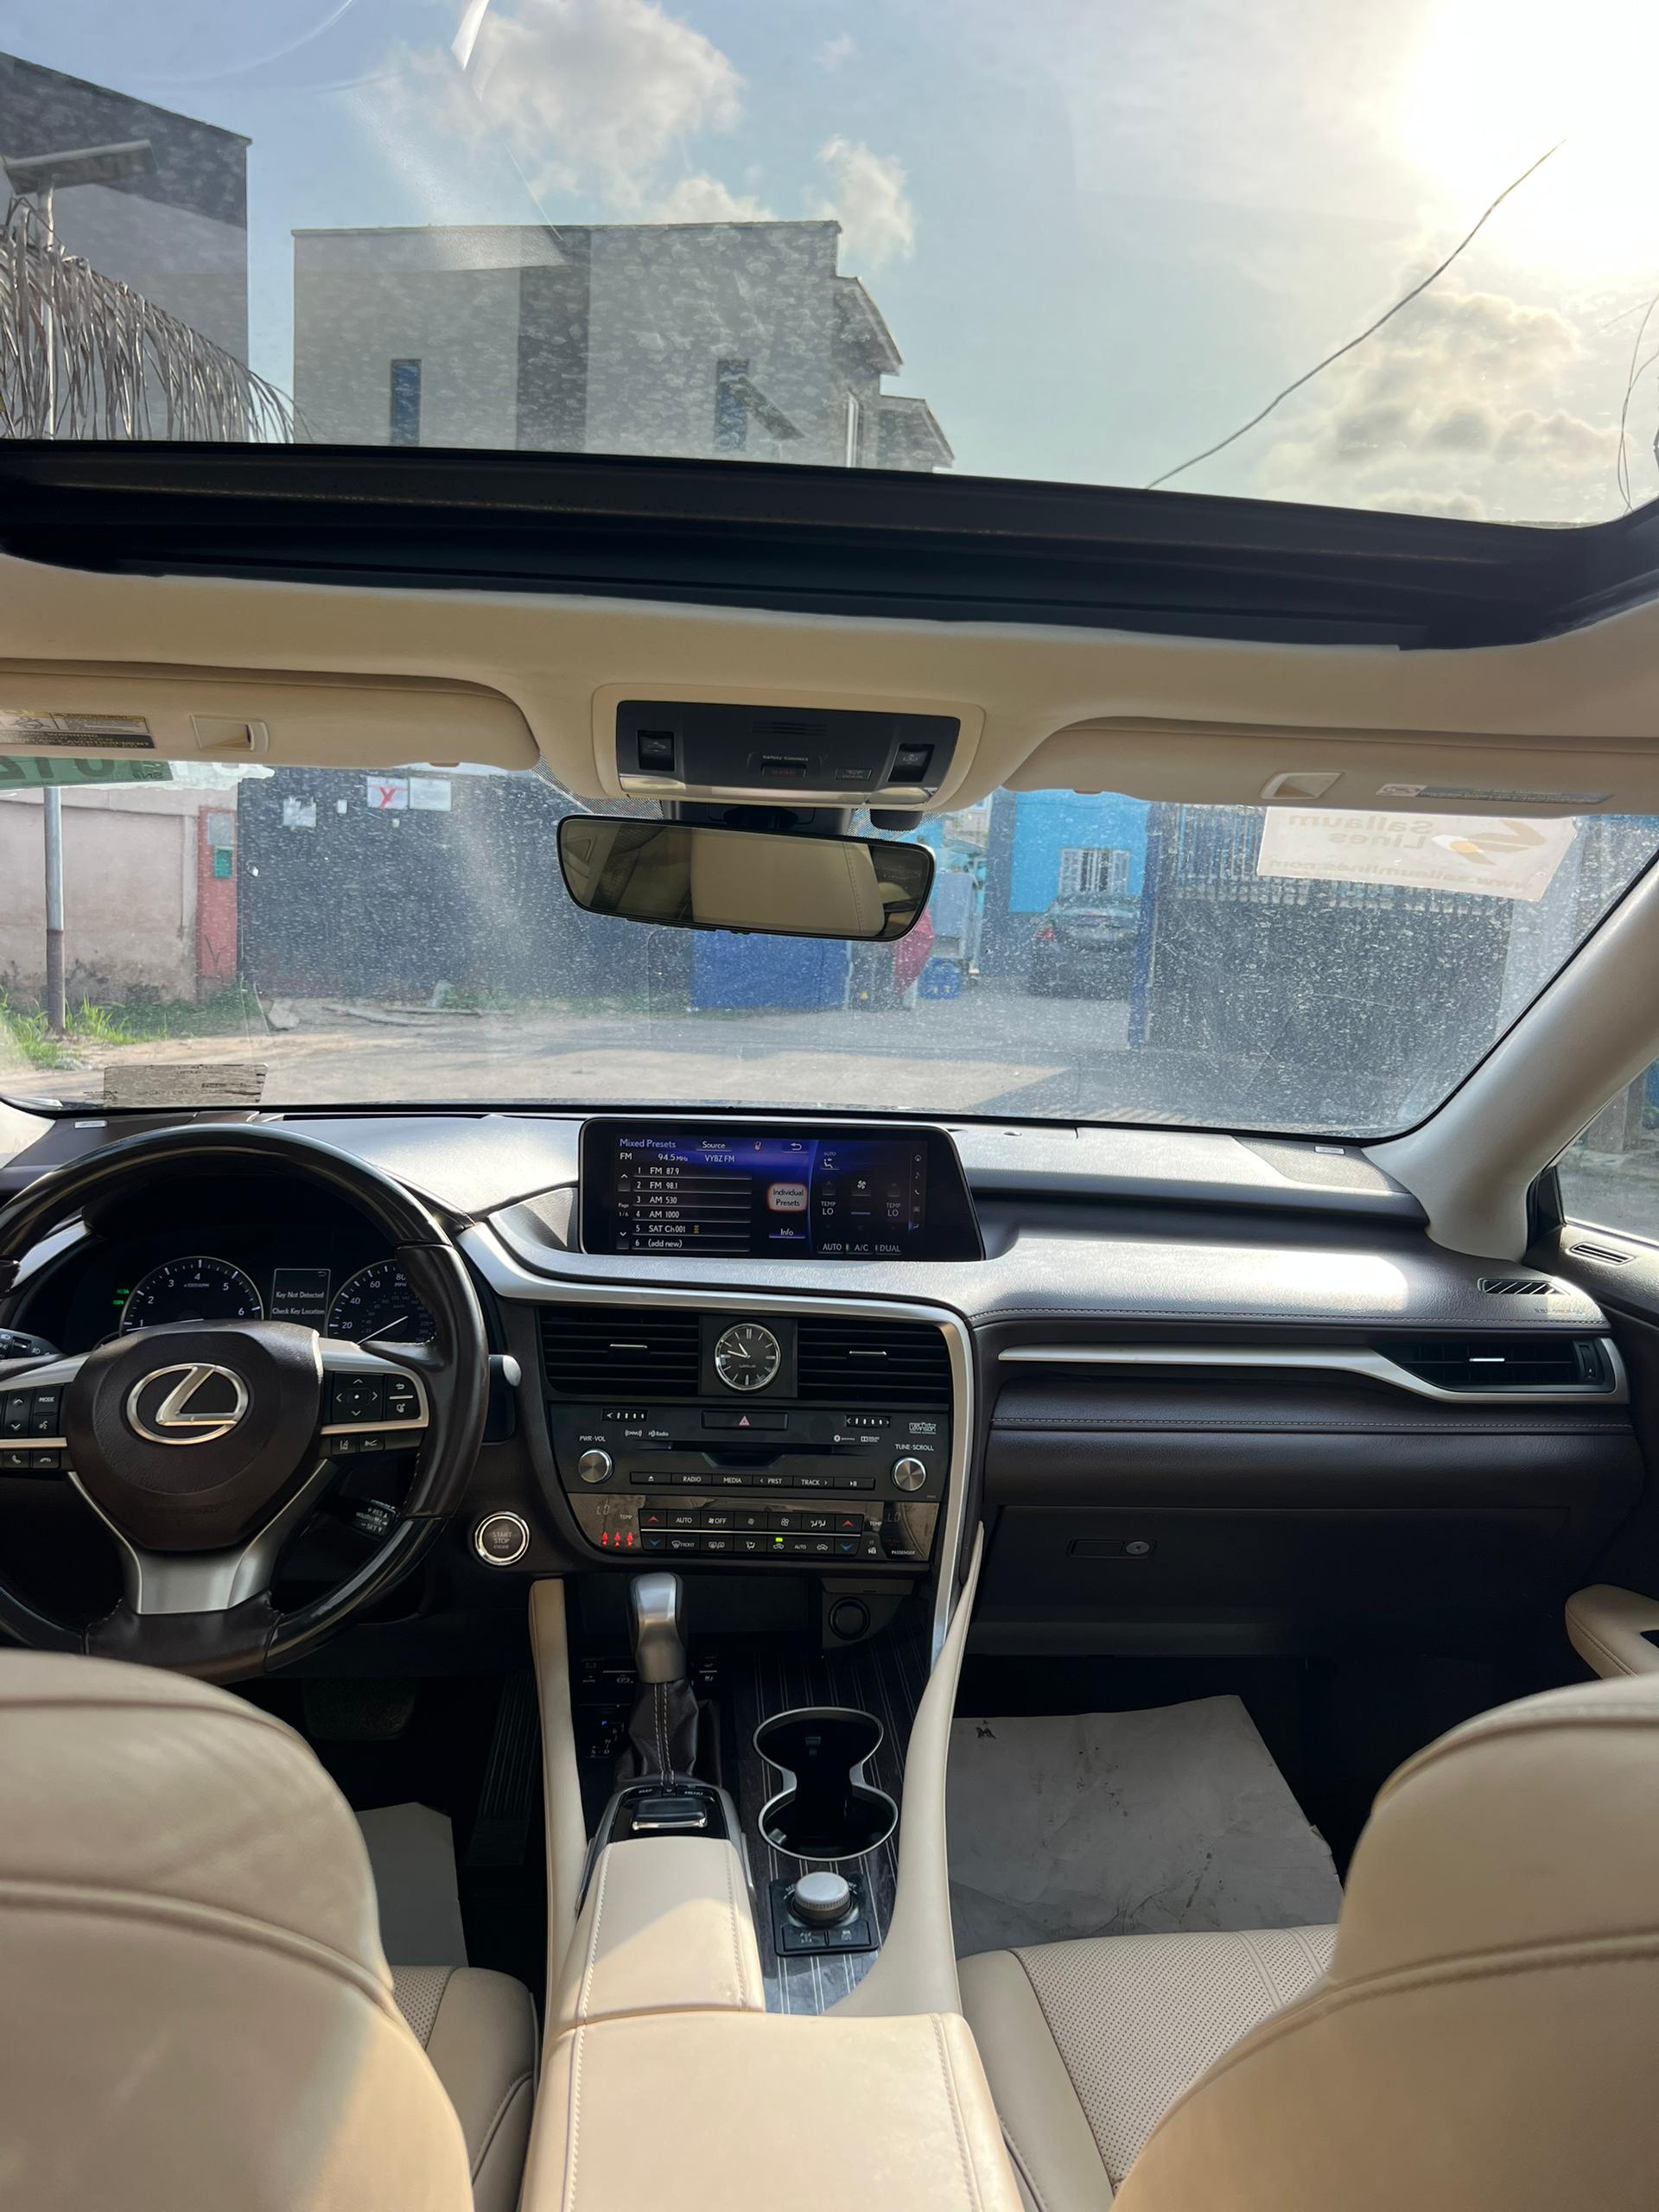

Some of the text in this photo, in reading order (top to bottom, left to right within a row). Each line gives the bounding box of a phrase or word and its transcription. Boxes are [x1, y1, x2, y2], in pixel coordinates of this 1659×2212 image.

[620, 1139, 677, 1148] Mixed Presets
[702, 1141, 726, 1149] Source
[780, 1228, 794, 1236] Info
[648, 1239, 664, 1249] (add
[664, 1239, 683, 1249] new)
[223, 1282, 229, 1291] 5
[148, 1296, 154, 1305] 2
[238, 1307, 245, 1316] 6
